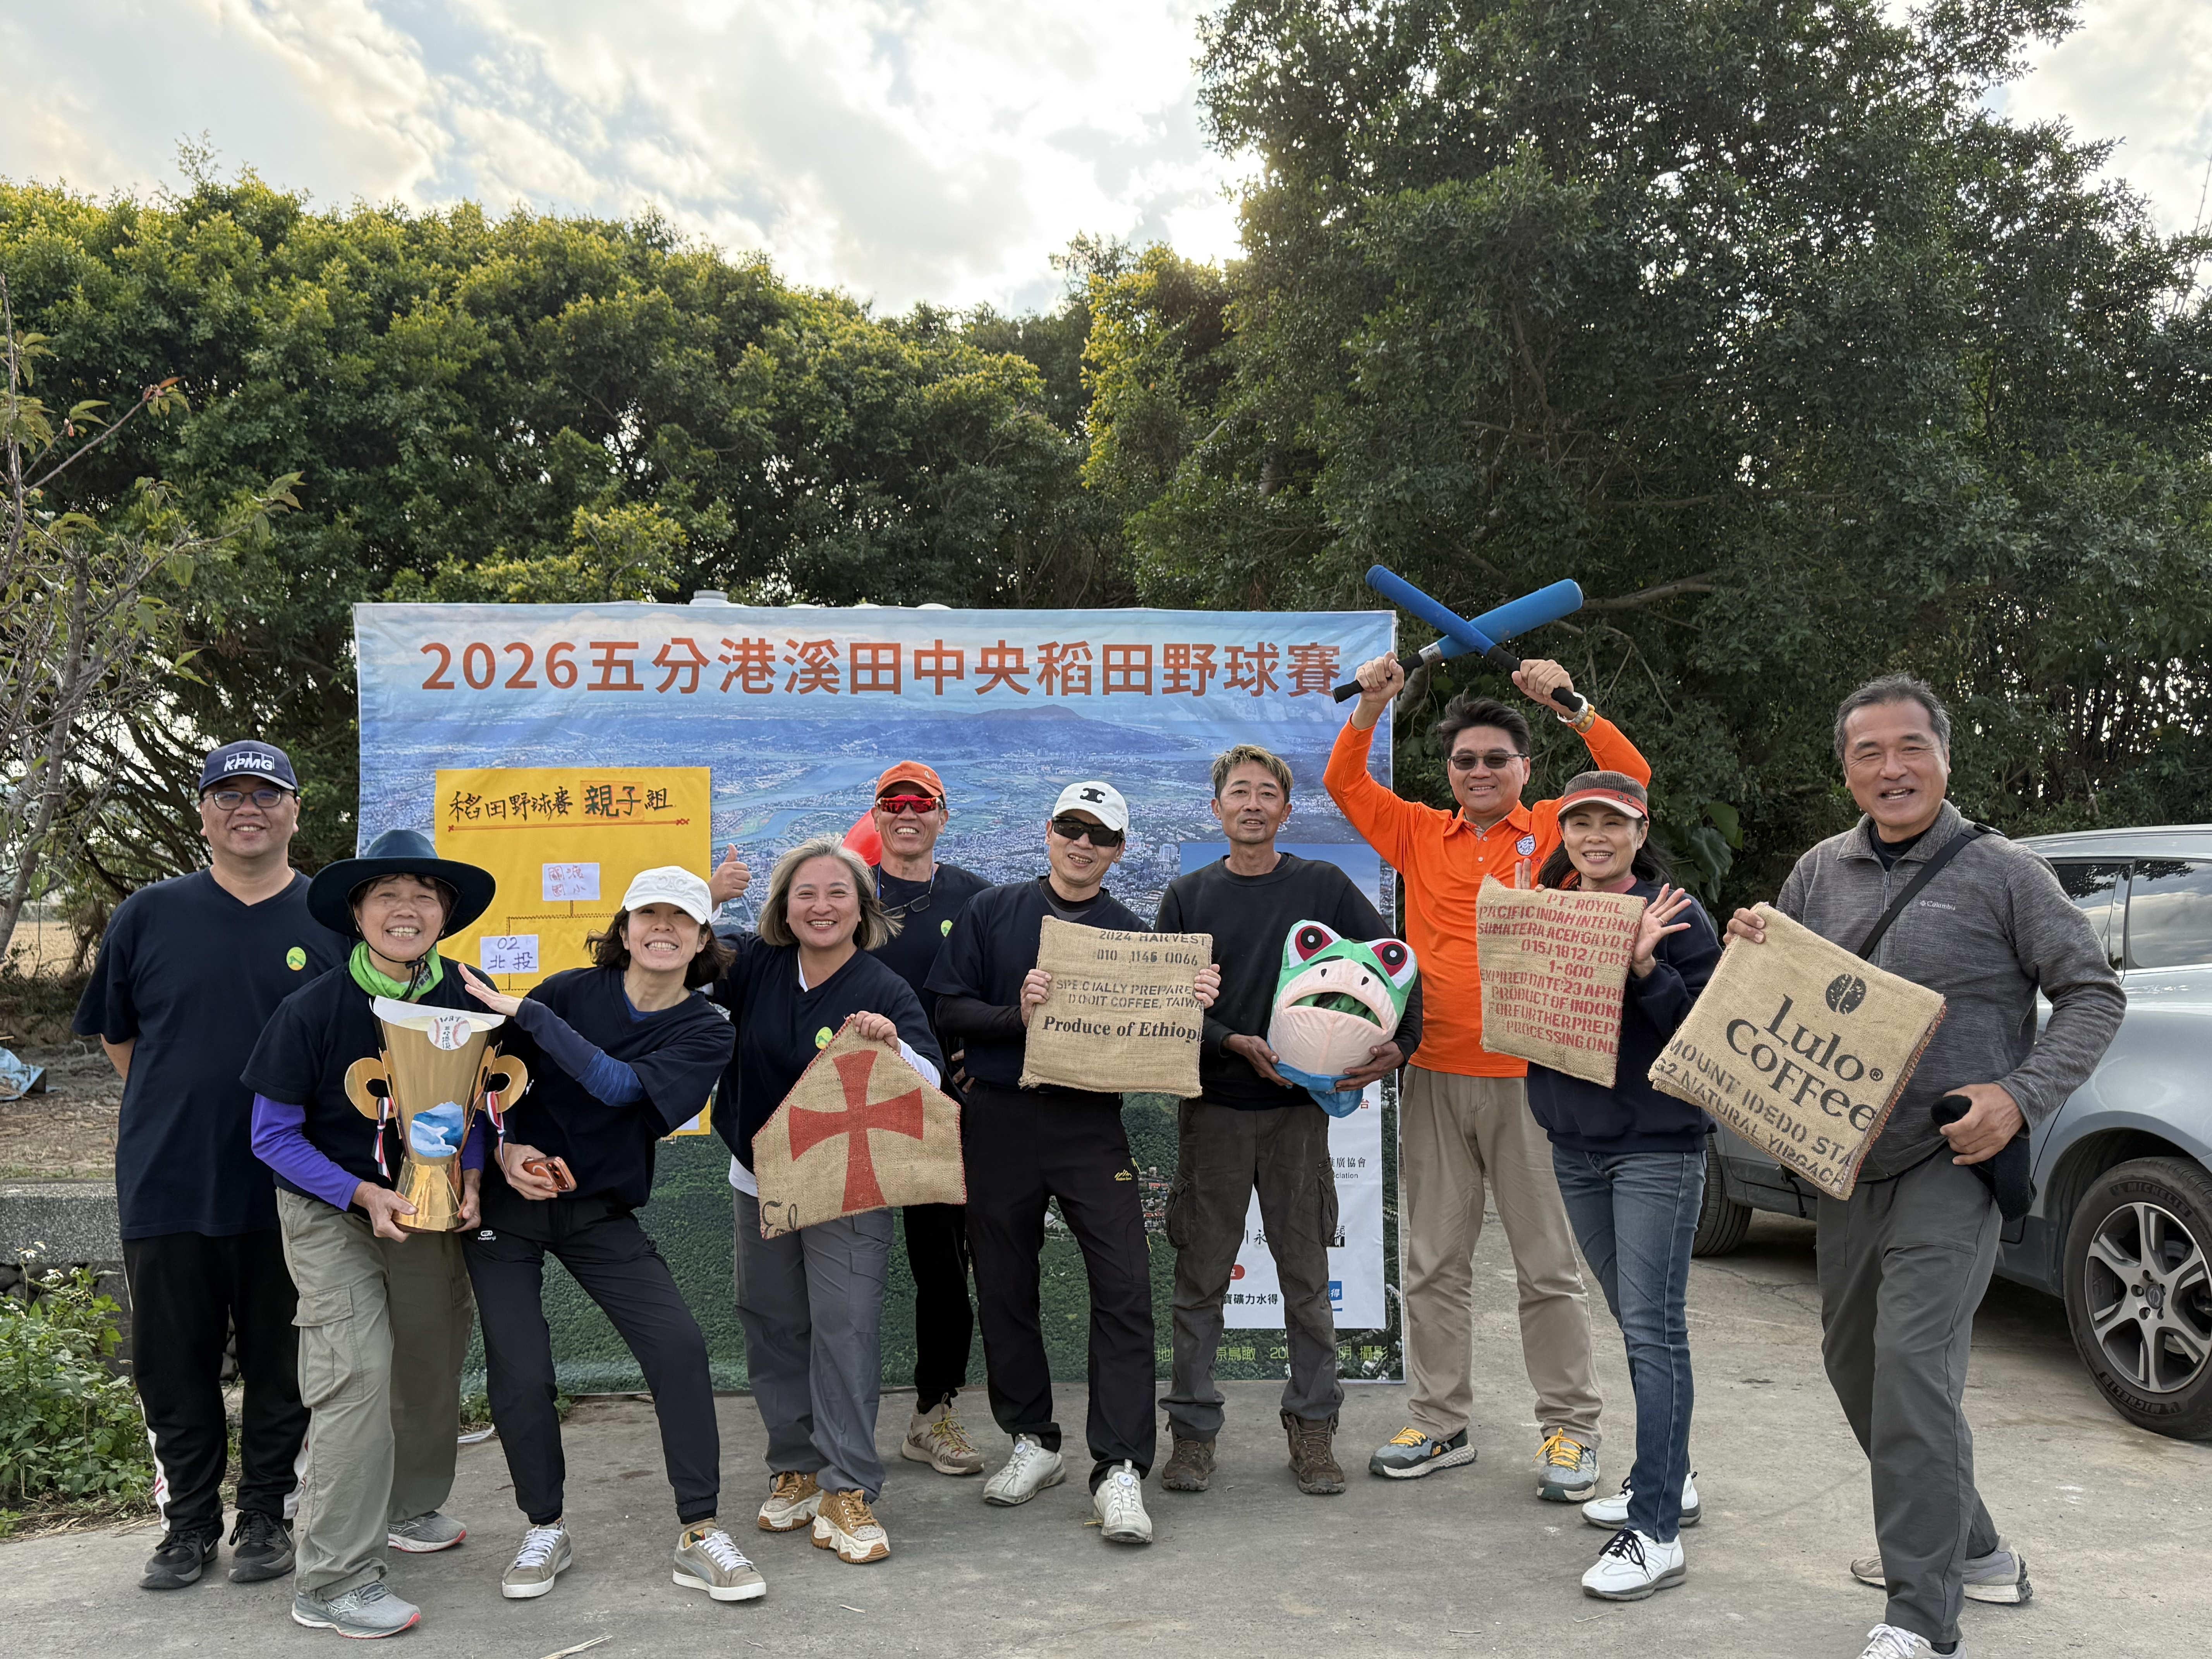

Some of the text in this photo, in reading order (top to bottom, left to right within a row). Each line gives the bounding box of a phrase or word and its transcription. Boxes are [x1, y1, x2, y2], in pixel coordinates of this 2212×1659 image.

[420, 637, 1341, 697] 2026五分港溪田中央稻田野球賽
[223, 757, 273, 772] KPMG
[1479, 905, 1535, 919] PACIFIC
[1099, 930, 1206, 946] 2024 HARVEST
[1477, 922, 1544, 937] SUMATERA
[1547, 926, 1580, 943] ACEH
[497, 936, 520, 950] 02
[487, 951, 537, 971] 北投
[1165, 951, 1198, 966] 0066
[1549, 959, 1594, 979] 1-600
[1056, 979, 1127, 993] SPECIALLY
[1492, 986, 1549, 1005] PRODUCT
[1551, 996, 1568, 1010] OF
[1042, 1016, 1111, 1036] Produce
[1116, 1022, 1135, 1037] of
[1506, 1020, 1584, 1048] PROCESSING
[1681, 1070, 1760, 1140] NATURAL
[1154, 1346, 1174, 1362] 地
